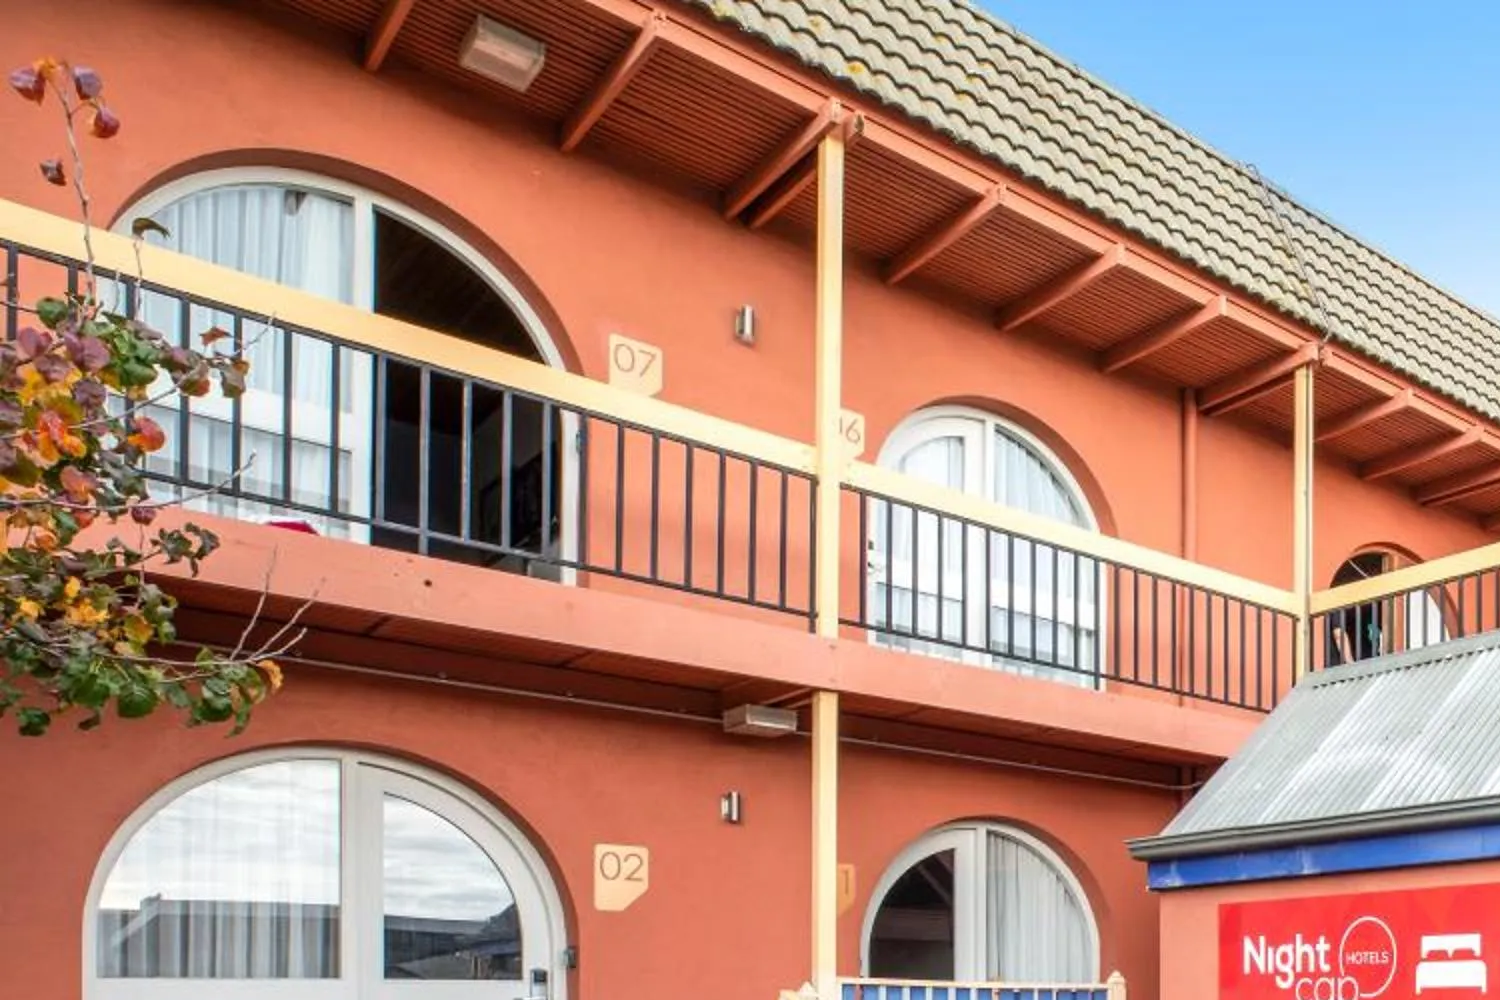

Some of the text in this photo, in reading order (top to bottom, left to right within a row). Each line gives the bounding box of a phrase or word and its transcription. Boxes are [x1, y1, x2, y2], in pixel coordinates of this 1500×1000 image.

[614, 343, 657, 377] 07
[839, 416, 861, 444] 6
[600, 851, 644, 882] 02
[1243, 933, 1332, 989] Night
[1346, 951, 1390, 965] HOTELS
